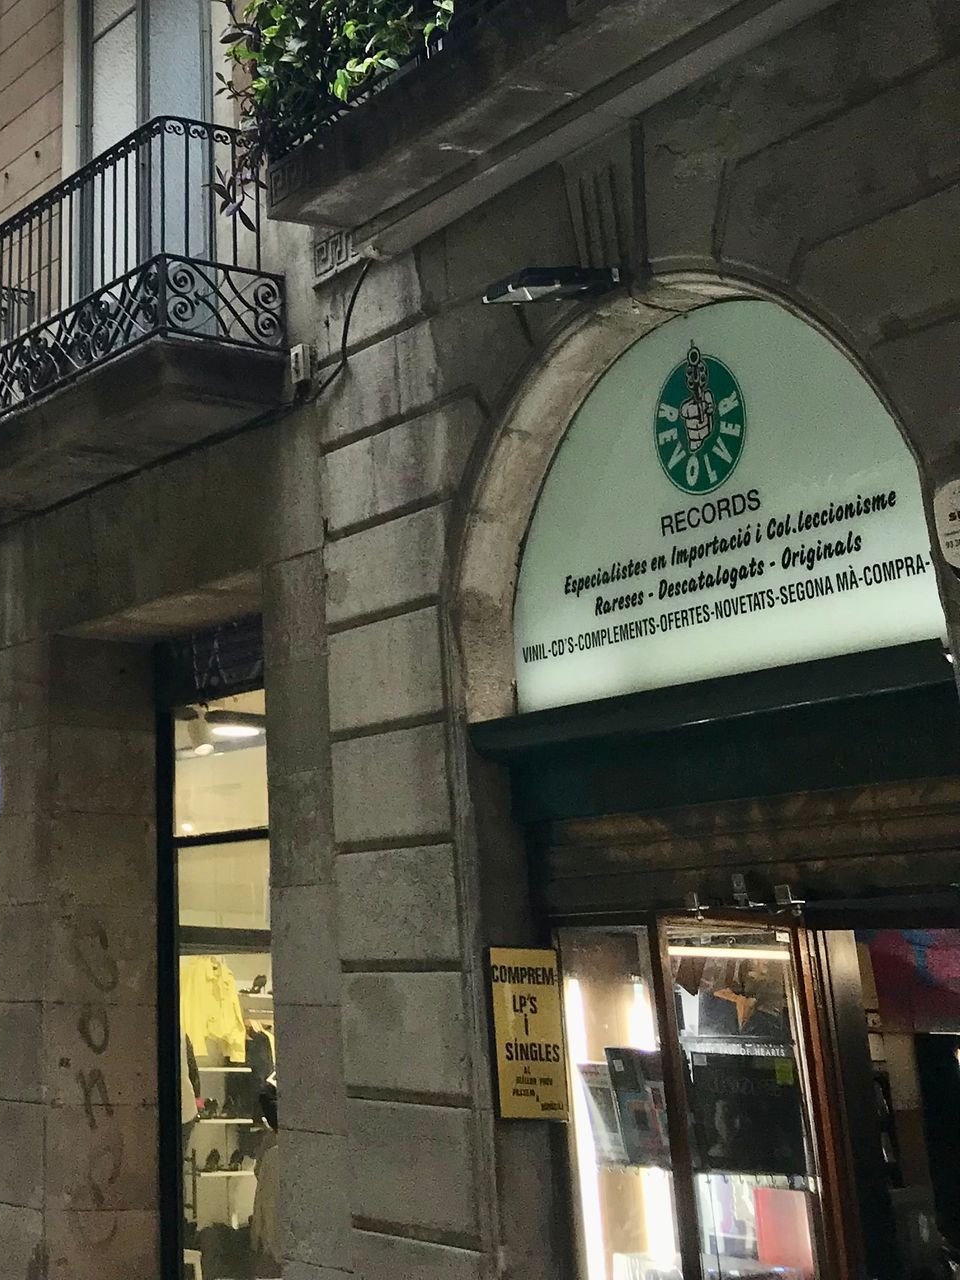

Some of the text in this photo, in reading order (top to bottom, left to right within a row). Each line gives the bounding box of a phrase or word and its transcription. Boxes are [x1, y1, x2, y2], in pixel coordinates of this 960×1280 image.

[658, 390, 742, 487] REVOLVER
[564, 490, 897, 597] Especialistes en Importació i Col.leccionisme
[660, 489, 761, 536] RECORDS
[594, 595, 644, 617] Rareses
[658, 557, 765, 600] Descatalogats
[781, 530, 862, 570] Originals
[512, 994, 537, 1014] LP'S
[754, 1048, 785, 1056] HEARTS
